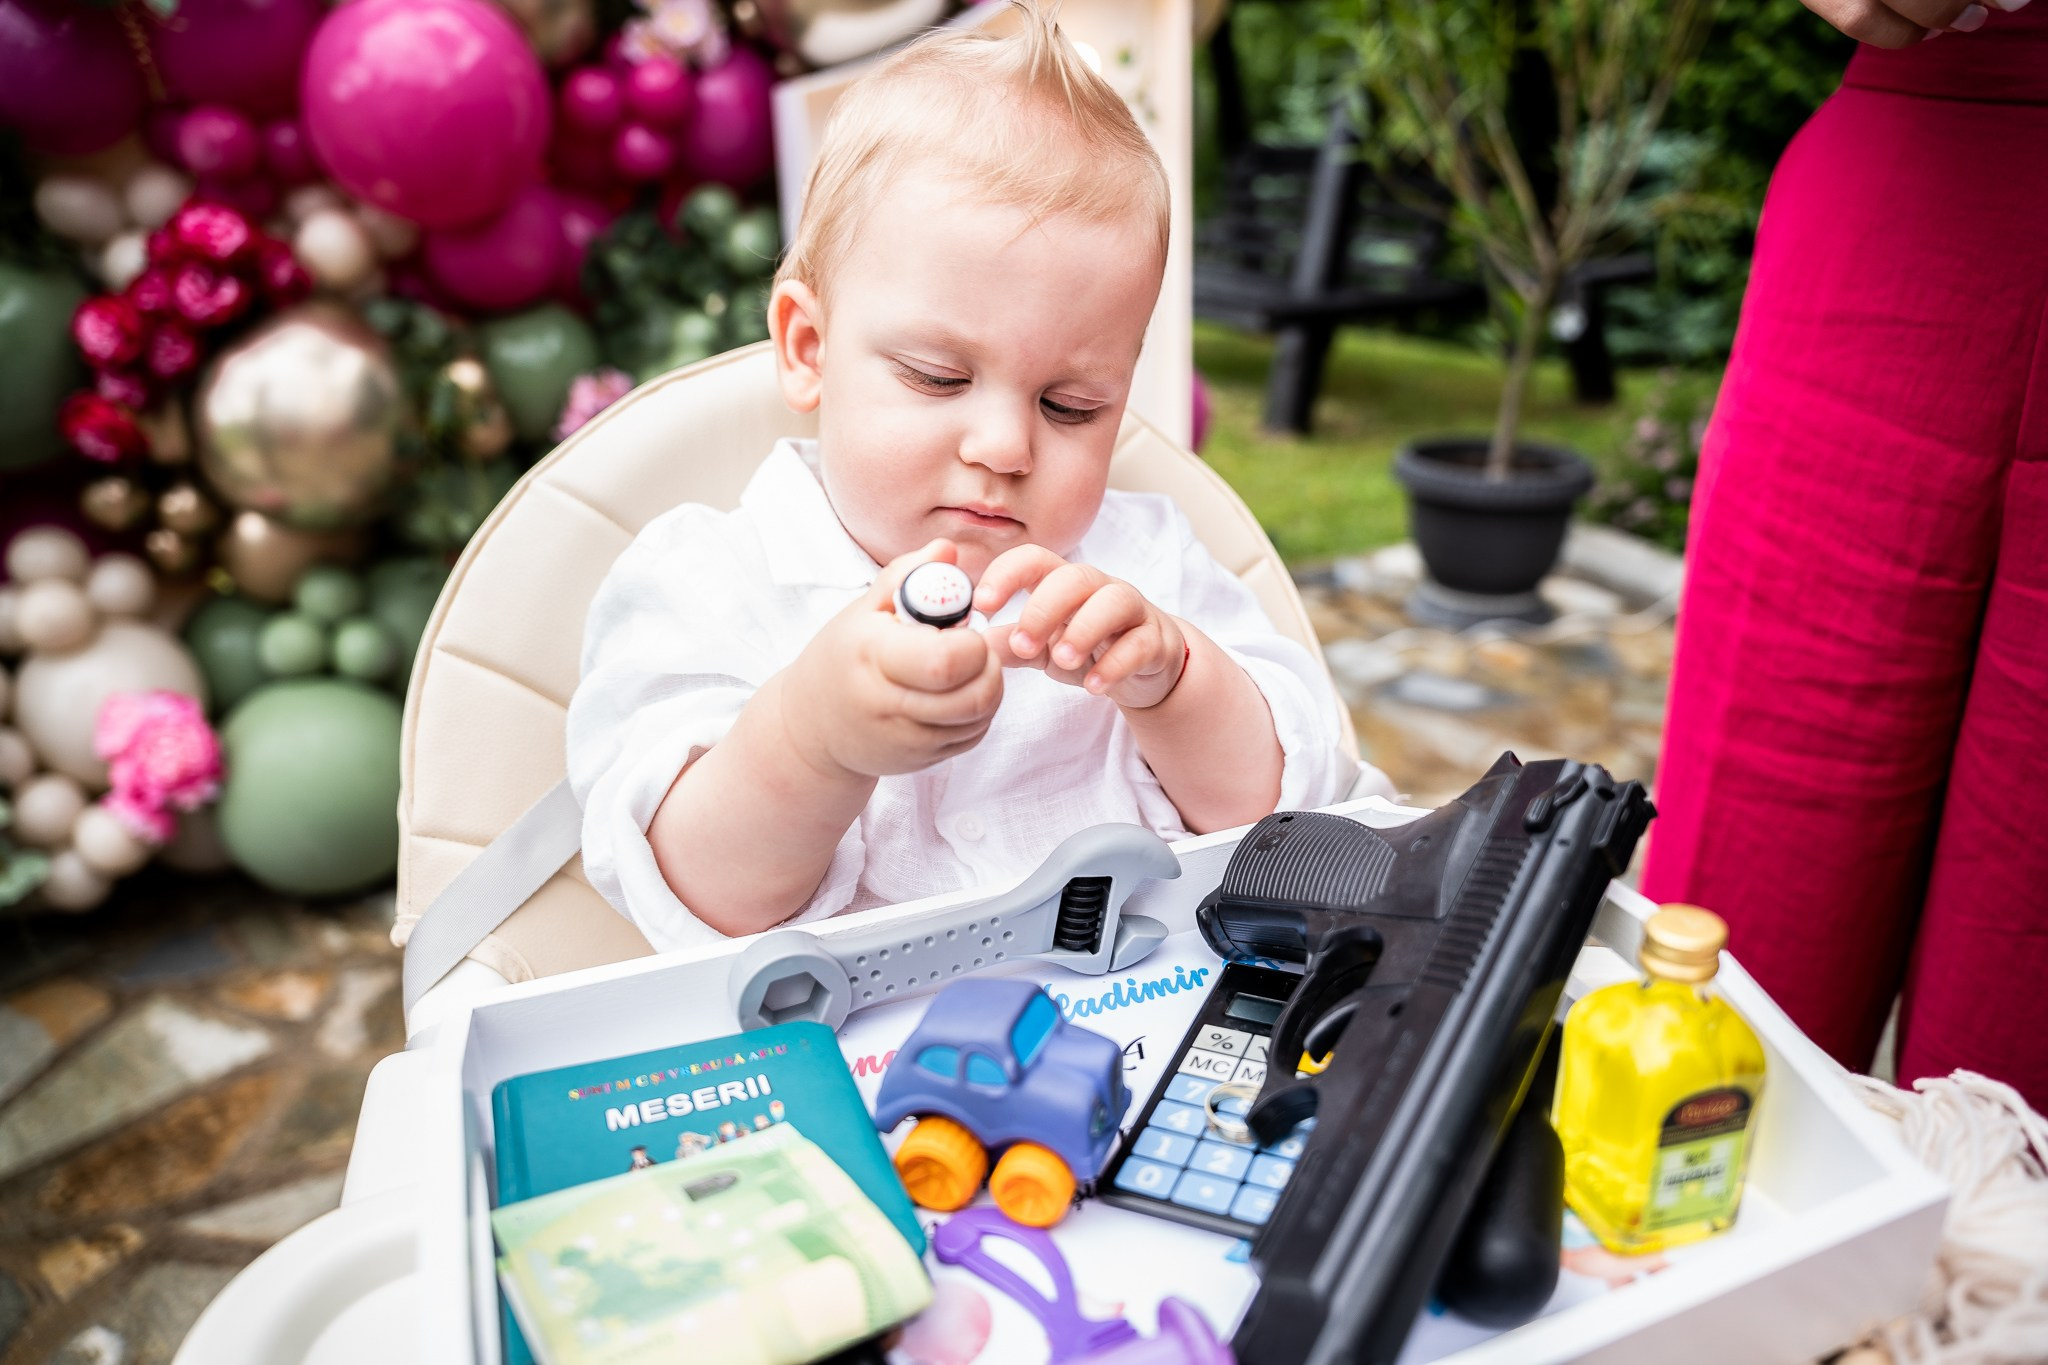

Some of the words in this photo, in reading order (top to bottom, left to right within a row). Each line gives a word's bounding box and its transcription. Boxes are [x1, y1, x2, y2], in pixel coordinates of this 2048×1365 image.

[616, 1074, 649, 1092] MIC
[668, 1058, 722, 1080] VREAU
[1189, 1055, 1231, 1074] MC
[1241, 1067, 1266, 1081] M
[604, 1073, 772, 1132] MESERII
[1184, 1081, 1207, 1100] 7
[1166, 1108, 1190, 1130] 4
[1156, 1136, 1173, 1156] 1
[1206, 1149, 1234, 1173] 2
[1135, 1165, 1162, 1188] 0
